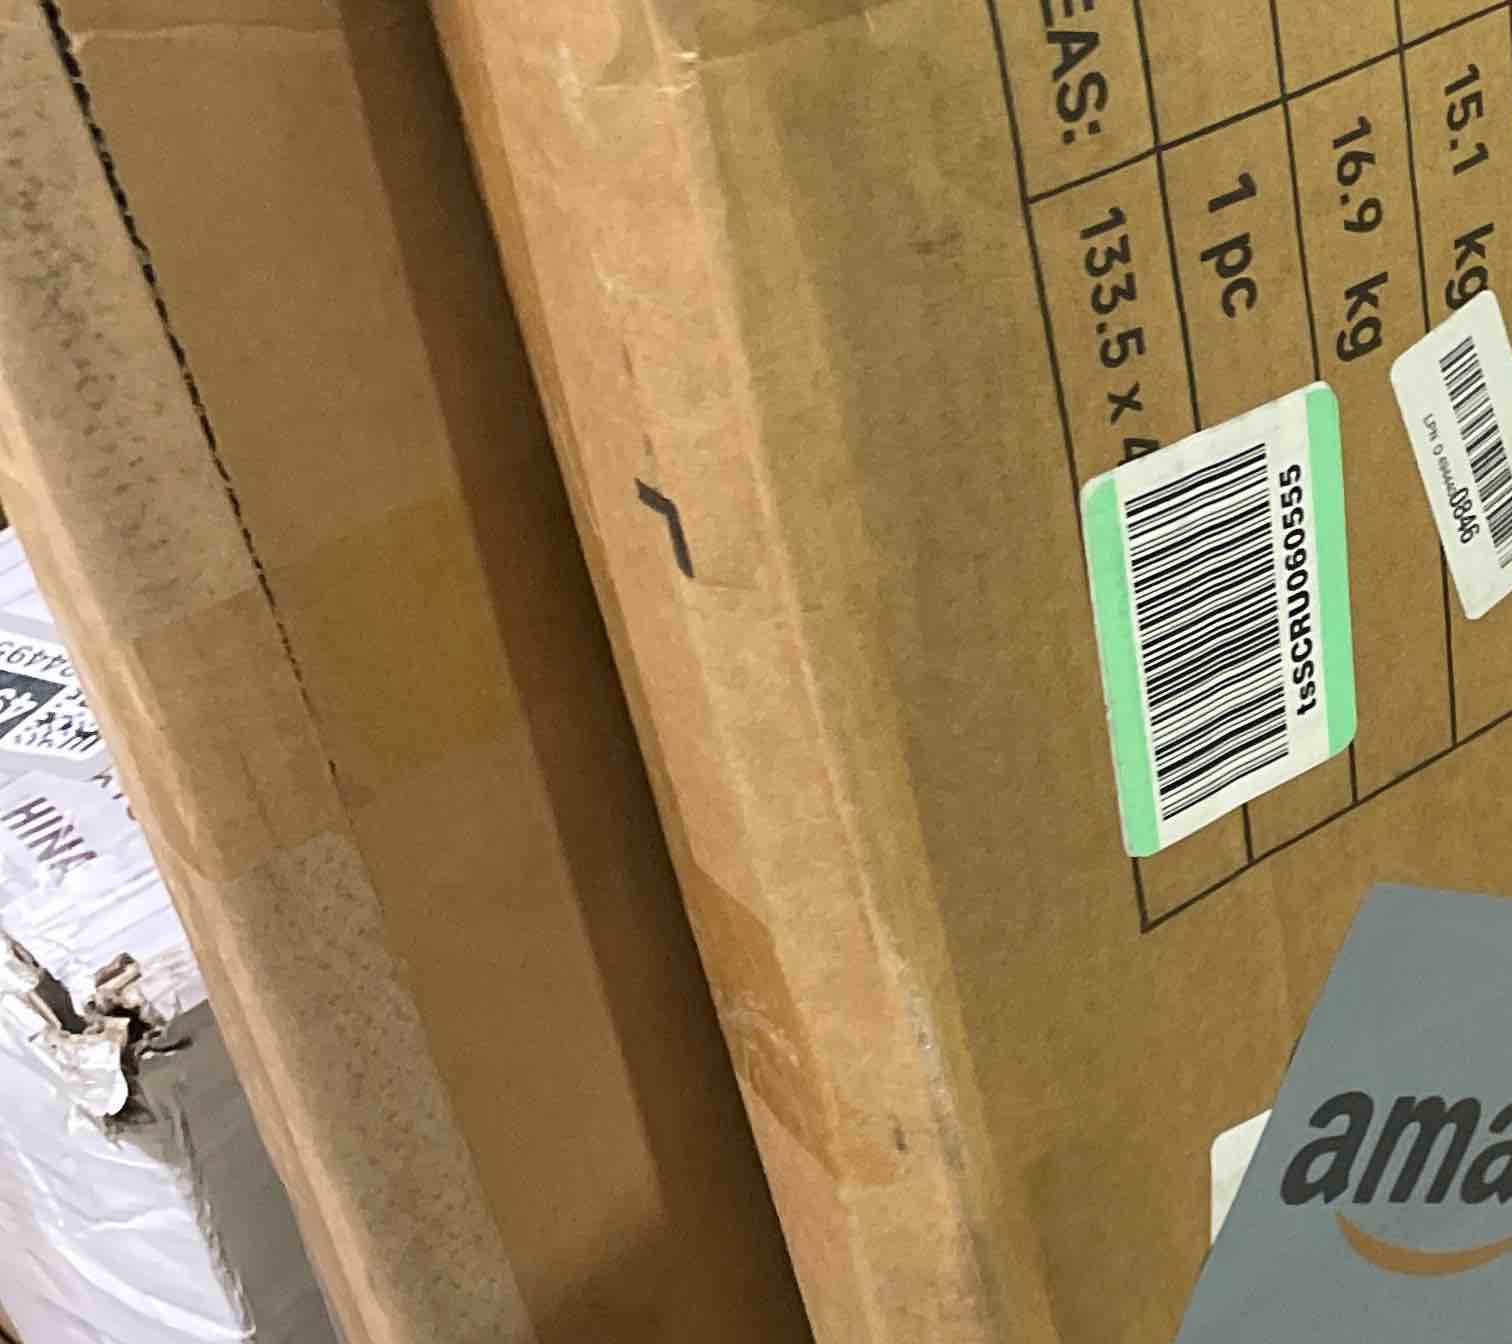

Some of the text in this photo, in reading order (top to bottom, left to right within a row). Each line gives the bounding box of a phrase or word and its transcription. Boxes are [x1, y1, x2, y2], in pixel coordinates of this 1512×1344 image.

[1079, 206, 1146, 369] 133.5
[1200, 172, 1258, 319] 1 pc
[1332, 115, 1389, 362] 16.9 kg
[1444, 63, 1495, 310] 15.1 kg
[1107, 380, 1143, 425] x
[1279, 464, 1317, 716] tsSCRU060555
